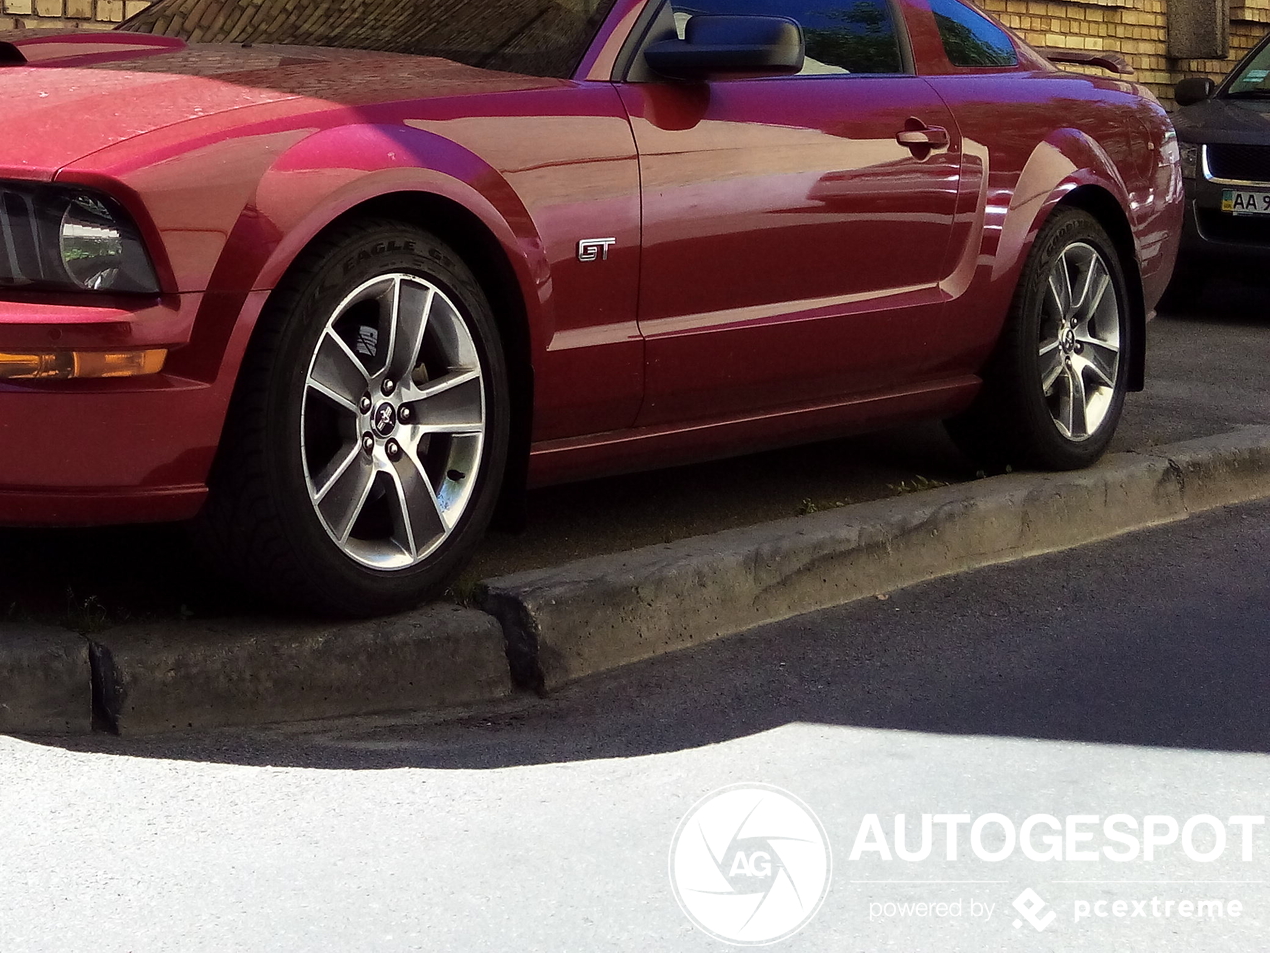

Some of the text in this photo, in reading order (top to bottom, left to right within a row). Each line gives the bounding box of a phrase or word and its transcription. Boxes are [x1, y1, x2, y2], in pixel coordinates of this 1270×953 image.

[1233, 193, 1257, 210] AA
[343, 240, 417, 275] EAGLE
[579, 237, 616, 261] GT
